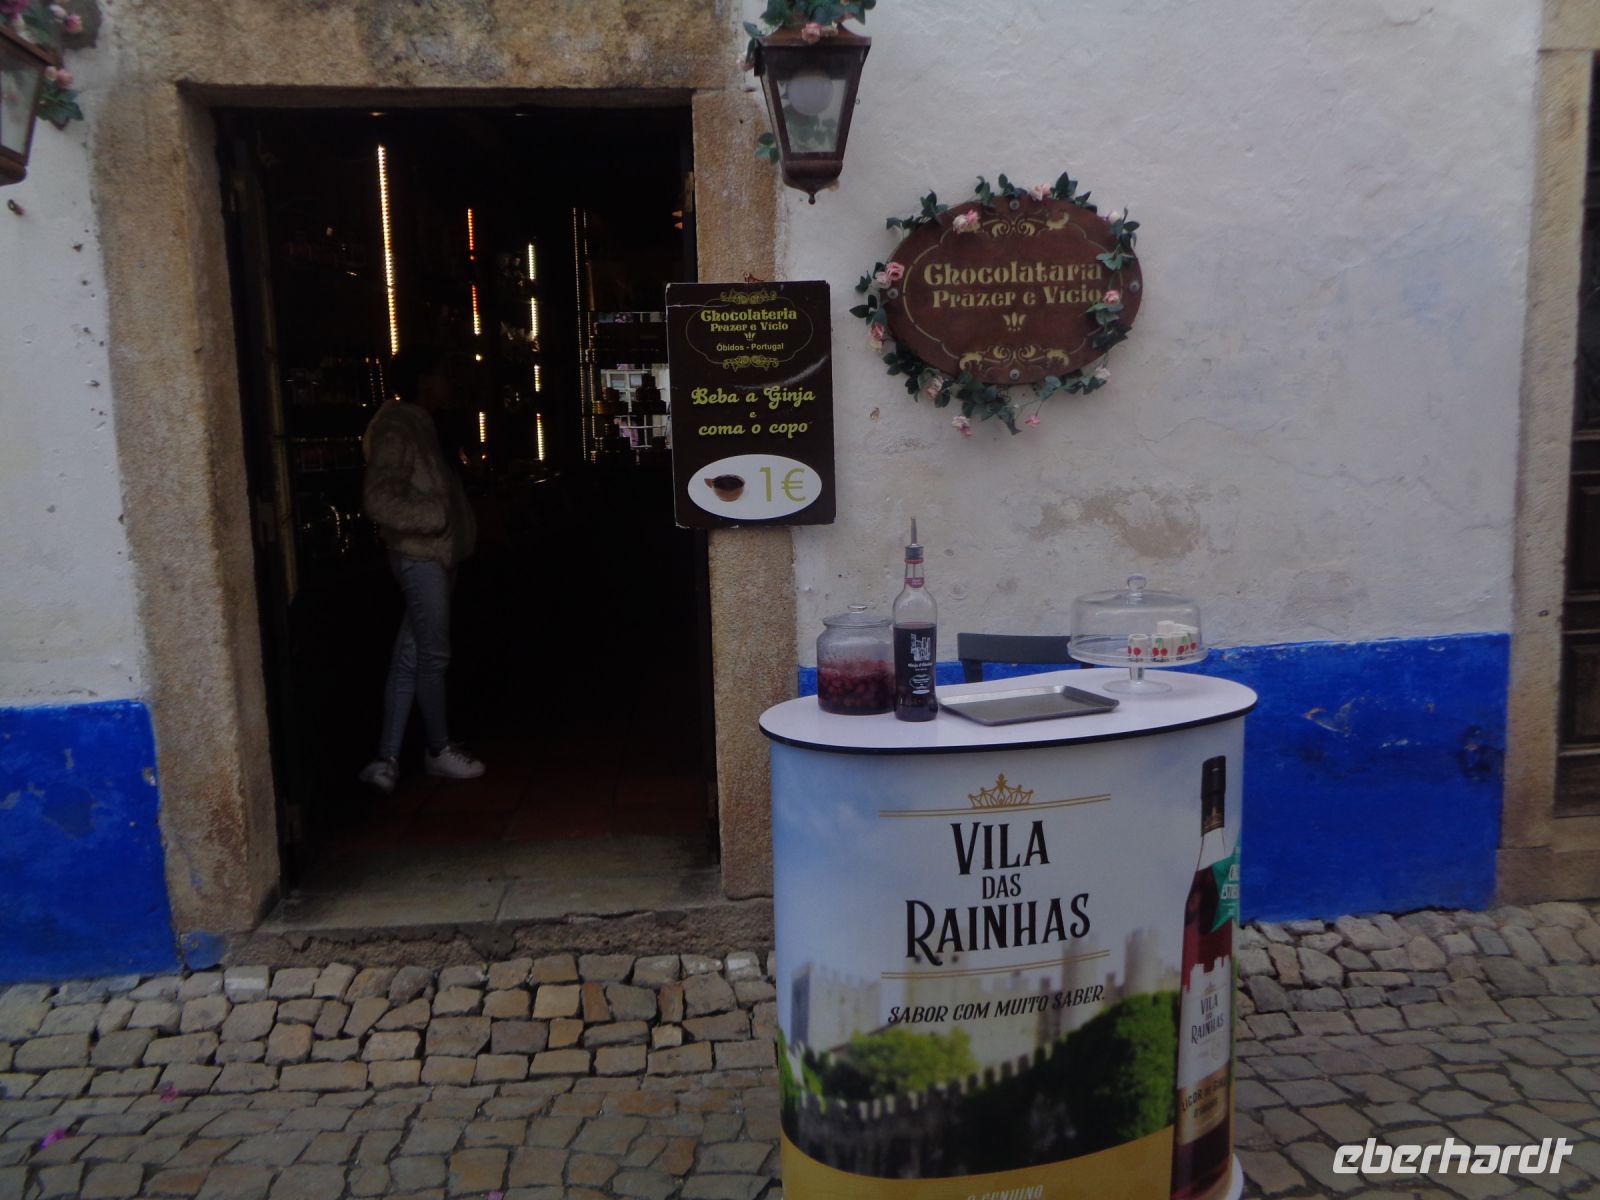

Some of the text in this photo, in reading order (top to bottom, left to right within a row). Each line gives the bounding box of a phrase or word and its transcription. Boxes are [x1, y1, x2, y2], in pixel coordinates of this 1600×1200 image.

[932, 289, 1016, 309] Prazer
[1022, 291, 1037, 306] e
[710, 322, 748, 333] Prazer
[750, 322, 758, 331] e
[750, 342, 785, 352] Portugal
[691, 385, 816, 410] Beba a Ginja
[698, 421, 809, 439] coma o copo
[950, 820, 1050, 875] VILA
[981, 873, 1022, 900] DAS
[905, 893, 1091, 967] RAINHAS
[888, 1005, 949, 1024] SABOR
[952, 1001, 991, 1021] COM
[994, 995, 1049, 1018] MUITO
[1200, 993, 1218, 1016] VILA
